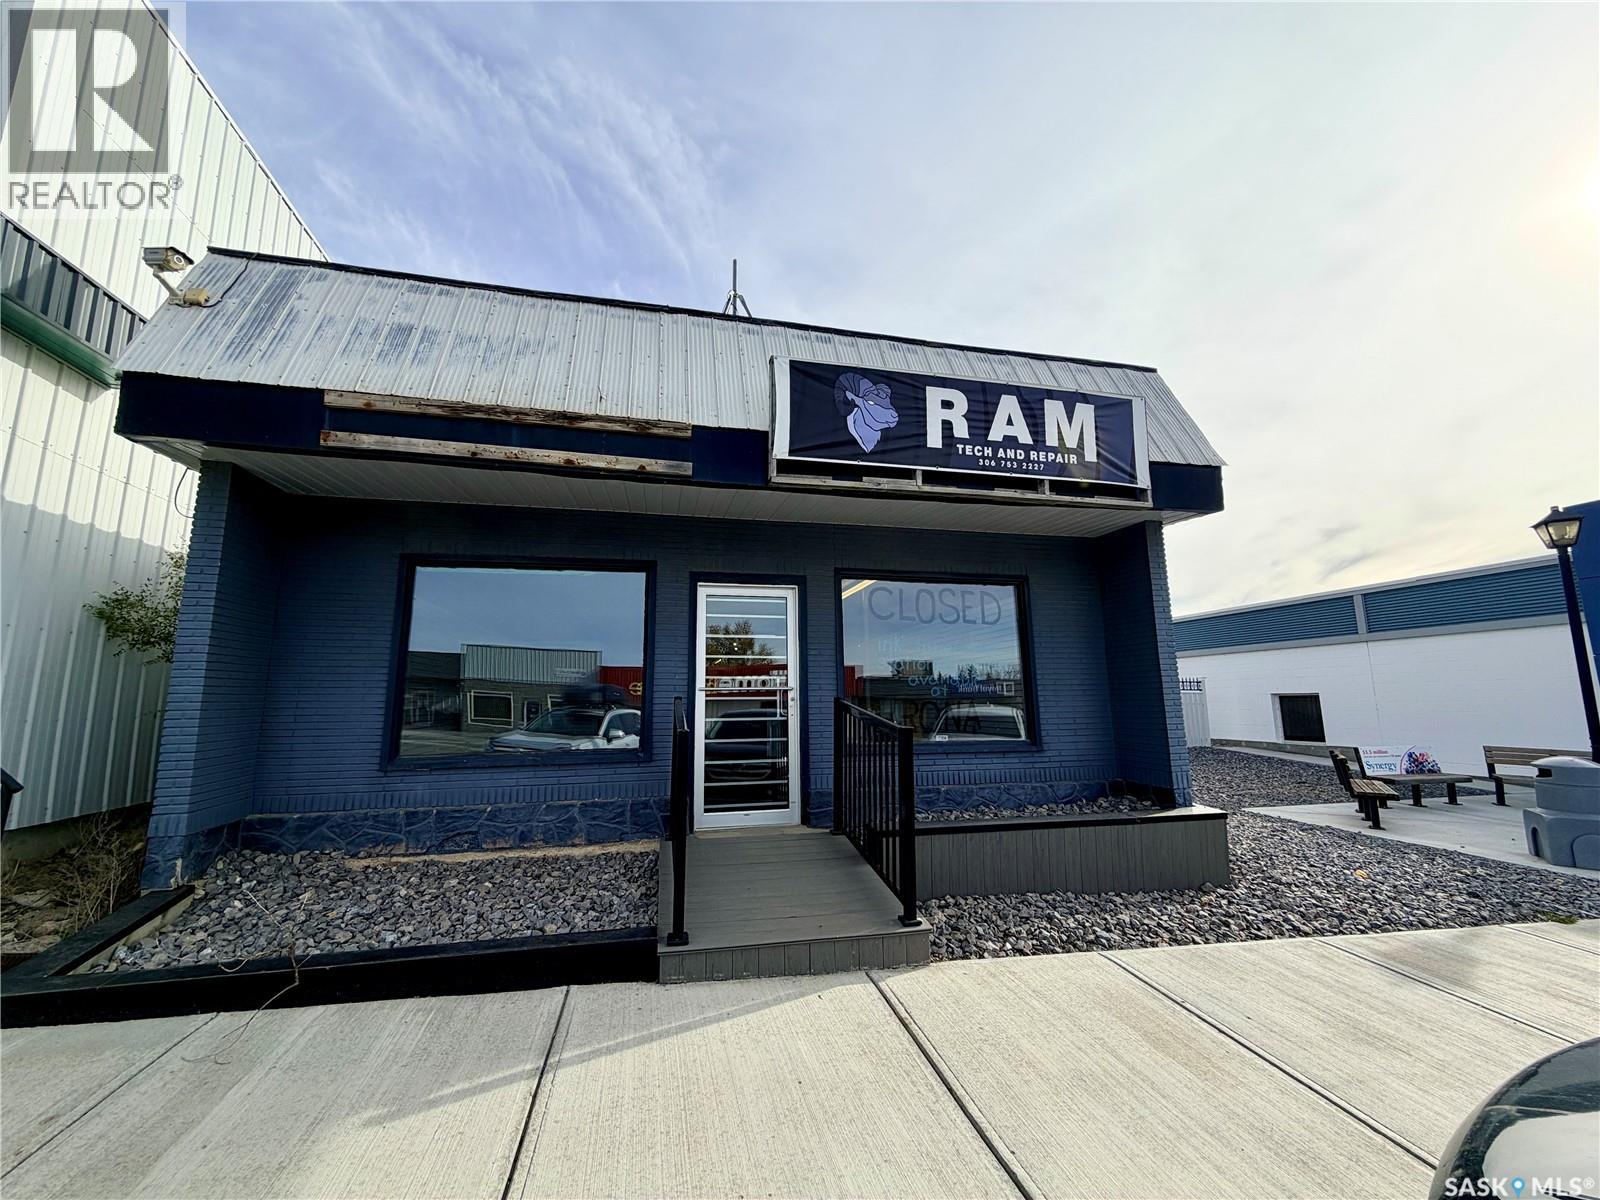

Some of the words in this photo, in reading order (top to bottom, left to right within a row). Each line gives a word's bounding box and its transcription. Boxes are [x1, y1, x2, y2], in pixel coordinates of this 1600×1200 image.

[925, 385, 1098, 463] RAM
[956, 444, 992, 457] TECH
[998, 448, 1025, 460] AND
[1030, 452, 1078, 465] REPAIR
[978, 458, 996, 467] 306
[1000, 460, 1018, 470] 753
[1022, 462, 1045, 471] 2227
[868, 586, 1002, 625] CLOSED
[1366, 760, 1397, 772] Synergy
